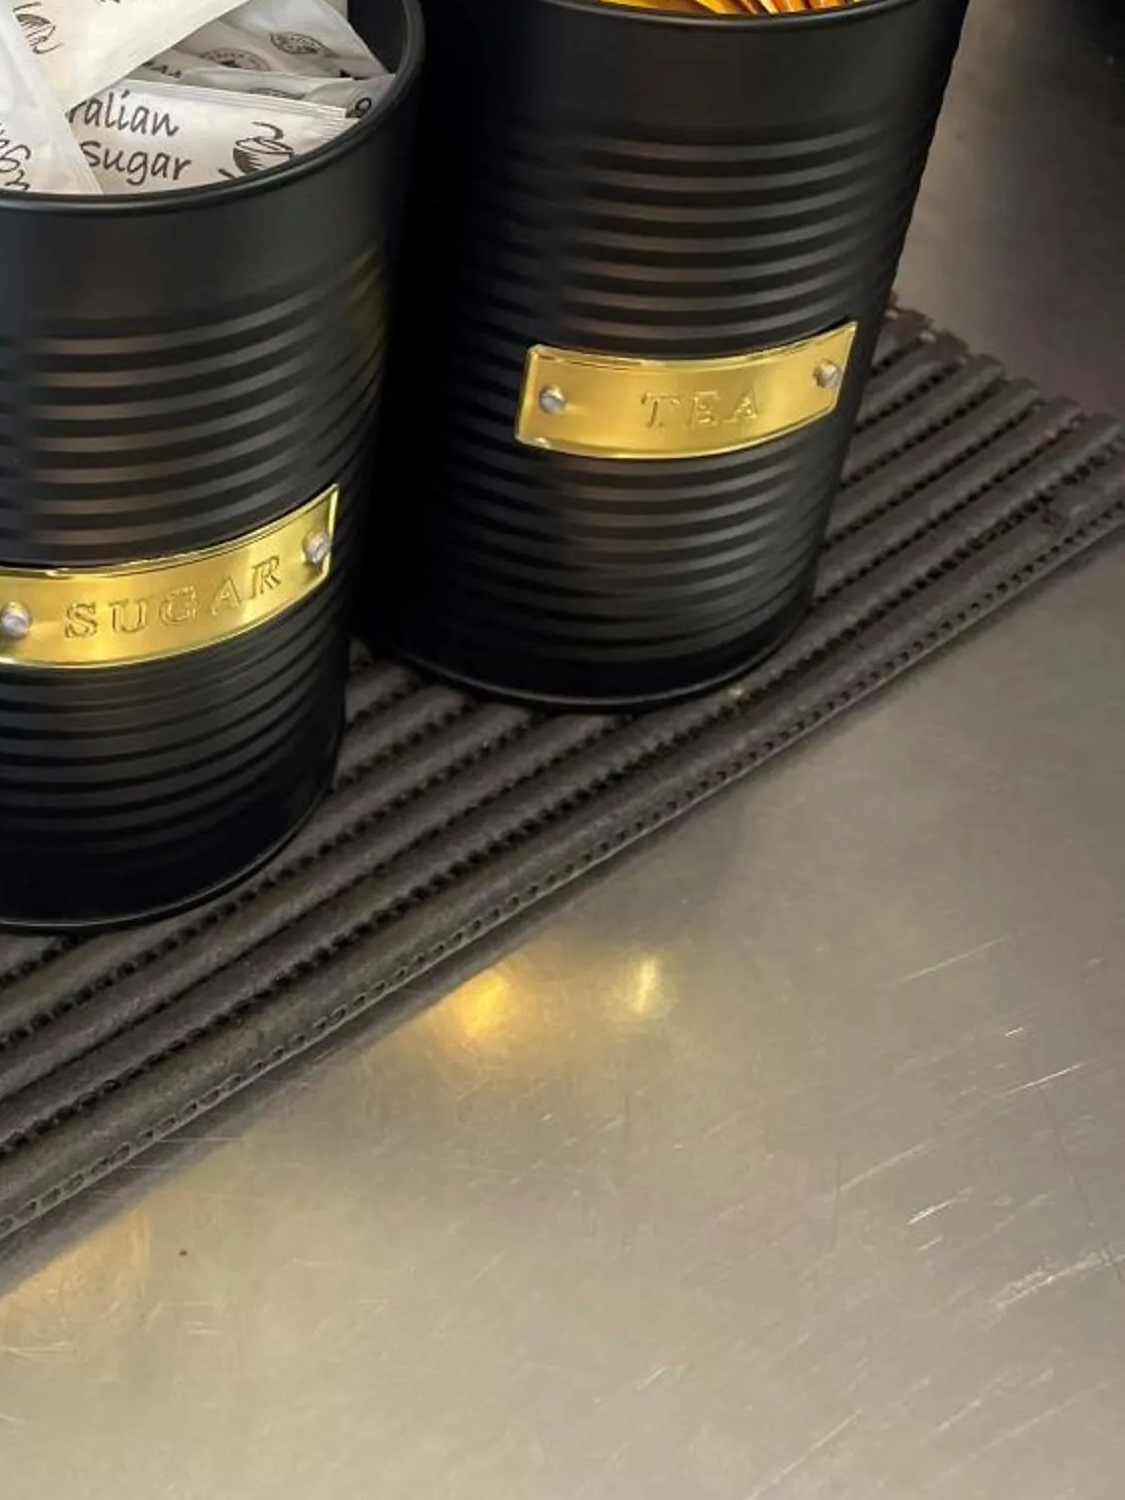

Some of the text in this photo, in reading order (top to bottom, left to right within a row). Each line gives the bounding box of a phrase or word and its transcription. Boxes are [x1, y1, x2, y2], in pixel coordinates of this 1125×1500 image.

[79, 141, 193, 186] Sugar
[641, 389, 760, 431] TEA
[64, 554, 281, 640] SUGAR
